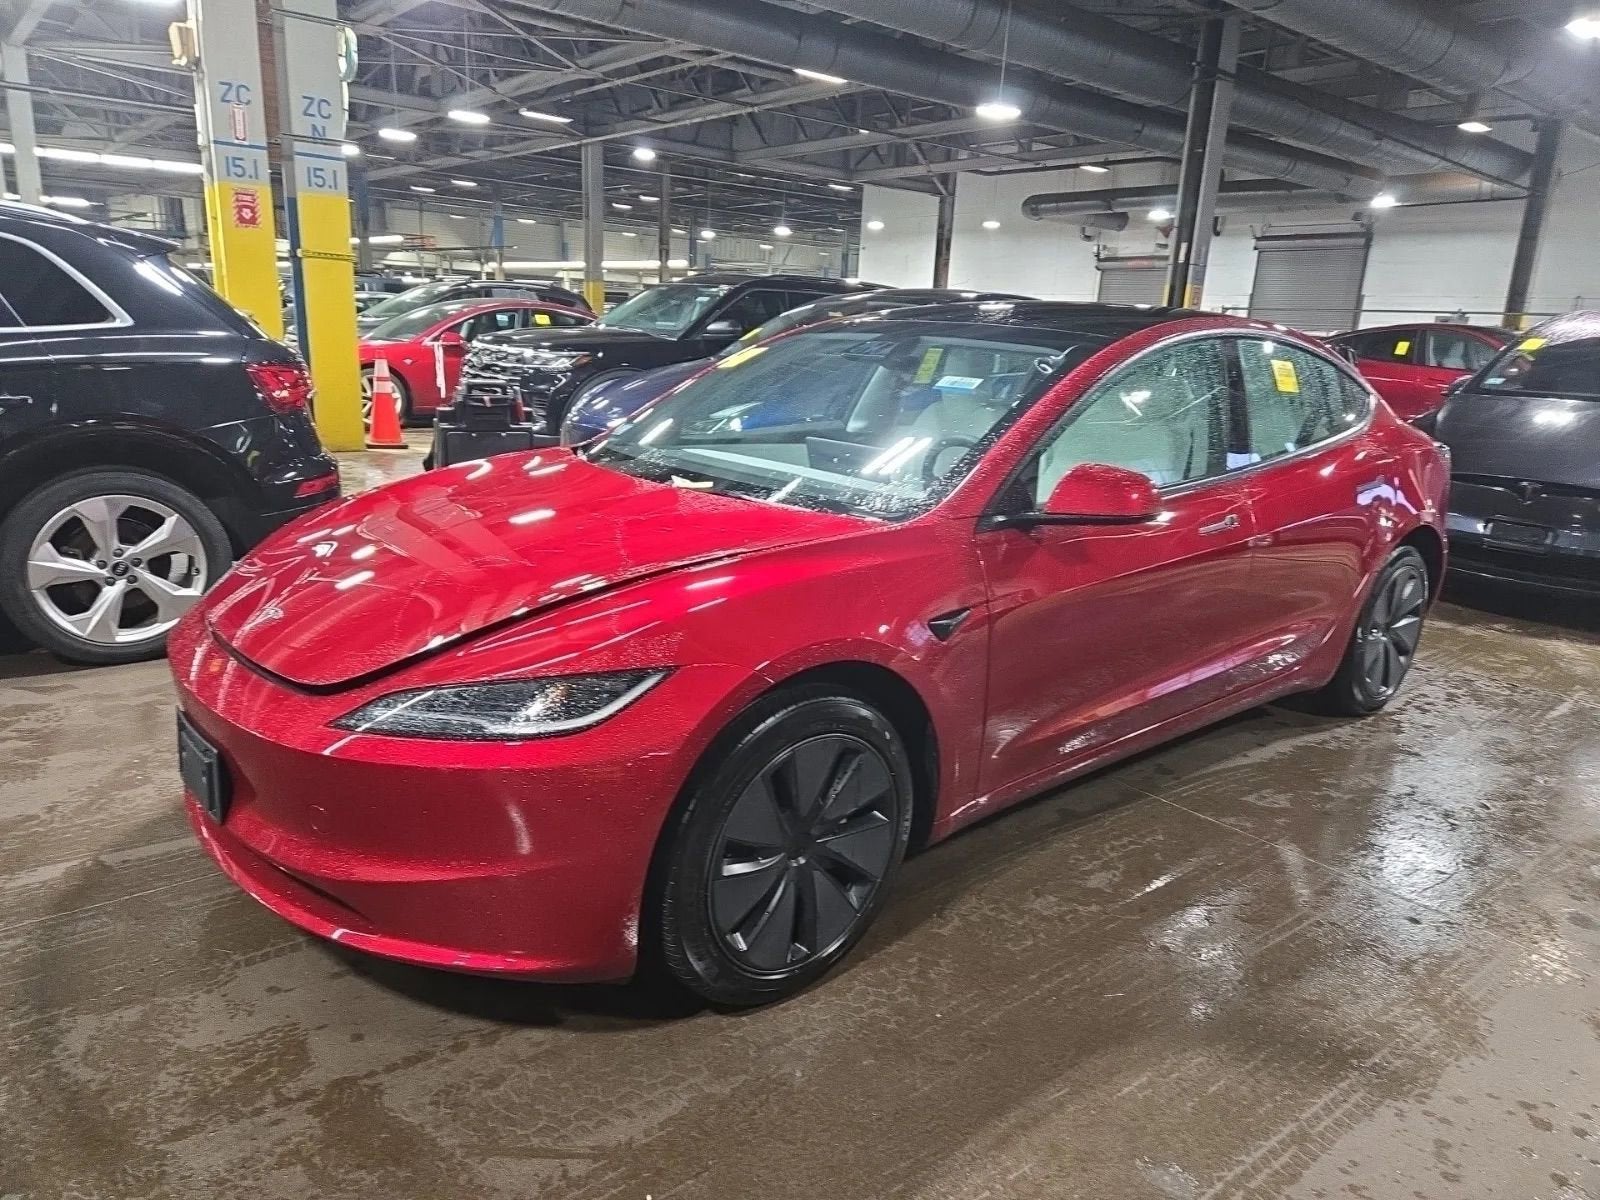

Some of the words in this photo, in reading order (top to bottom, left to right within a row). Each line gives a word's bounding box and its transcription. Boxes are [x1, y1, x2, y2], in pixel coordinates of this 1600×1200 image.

[219, 81, 252, 105] ZC
[302, 95, 332, 120] ZC
[311, 123, 327, 141] N
[225, 155, 259, 180] 15.1
[306, 166, 338, 190] 15.1
